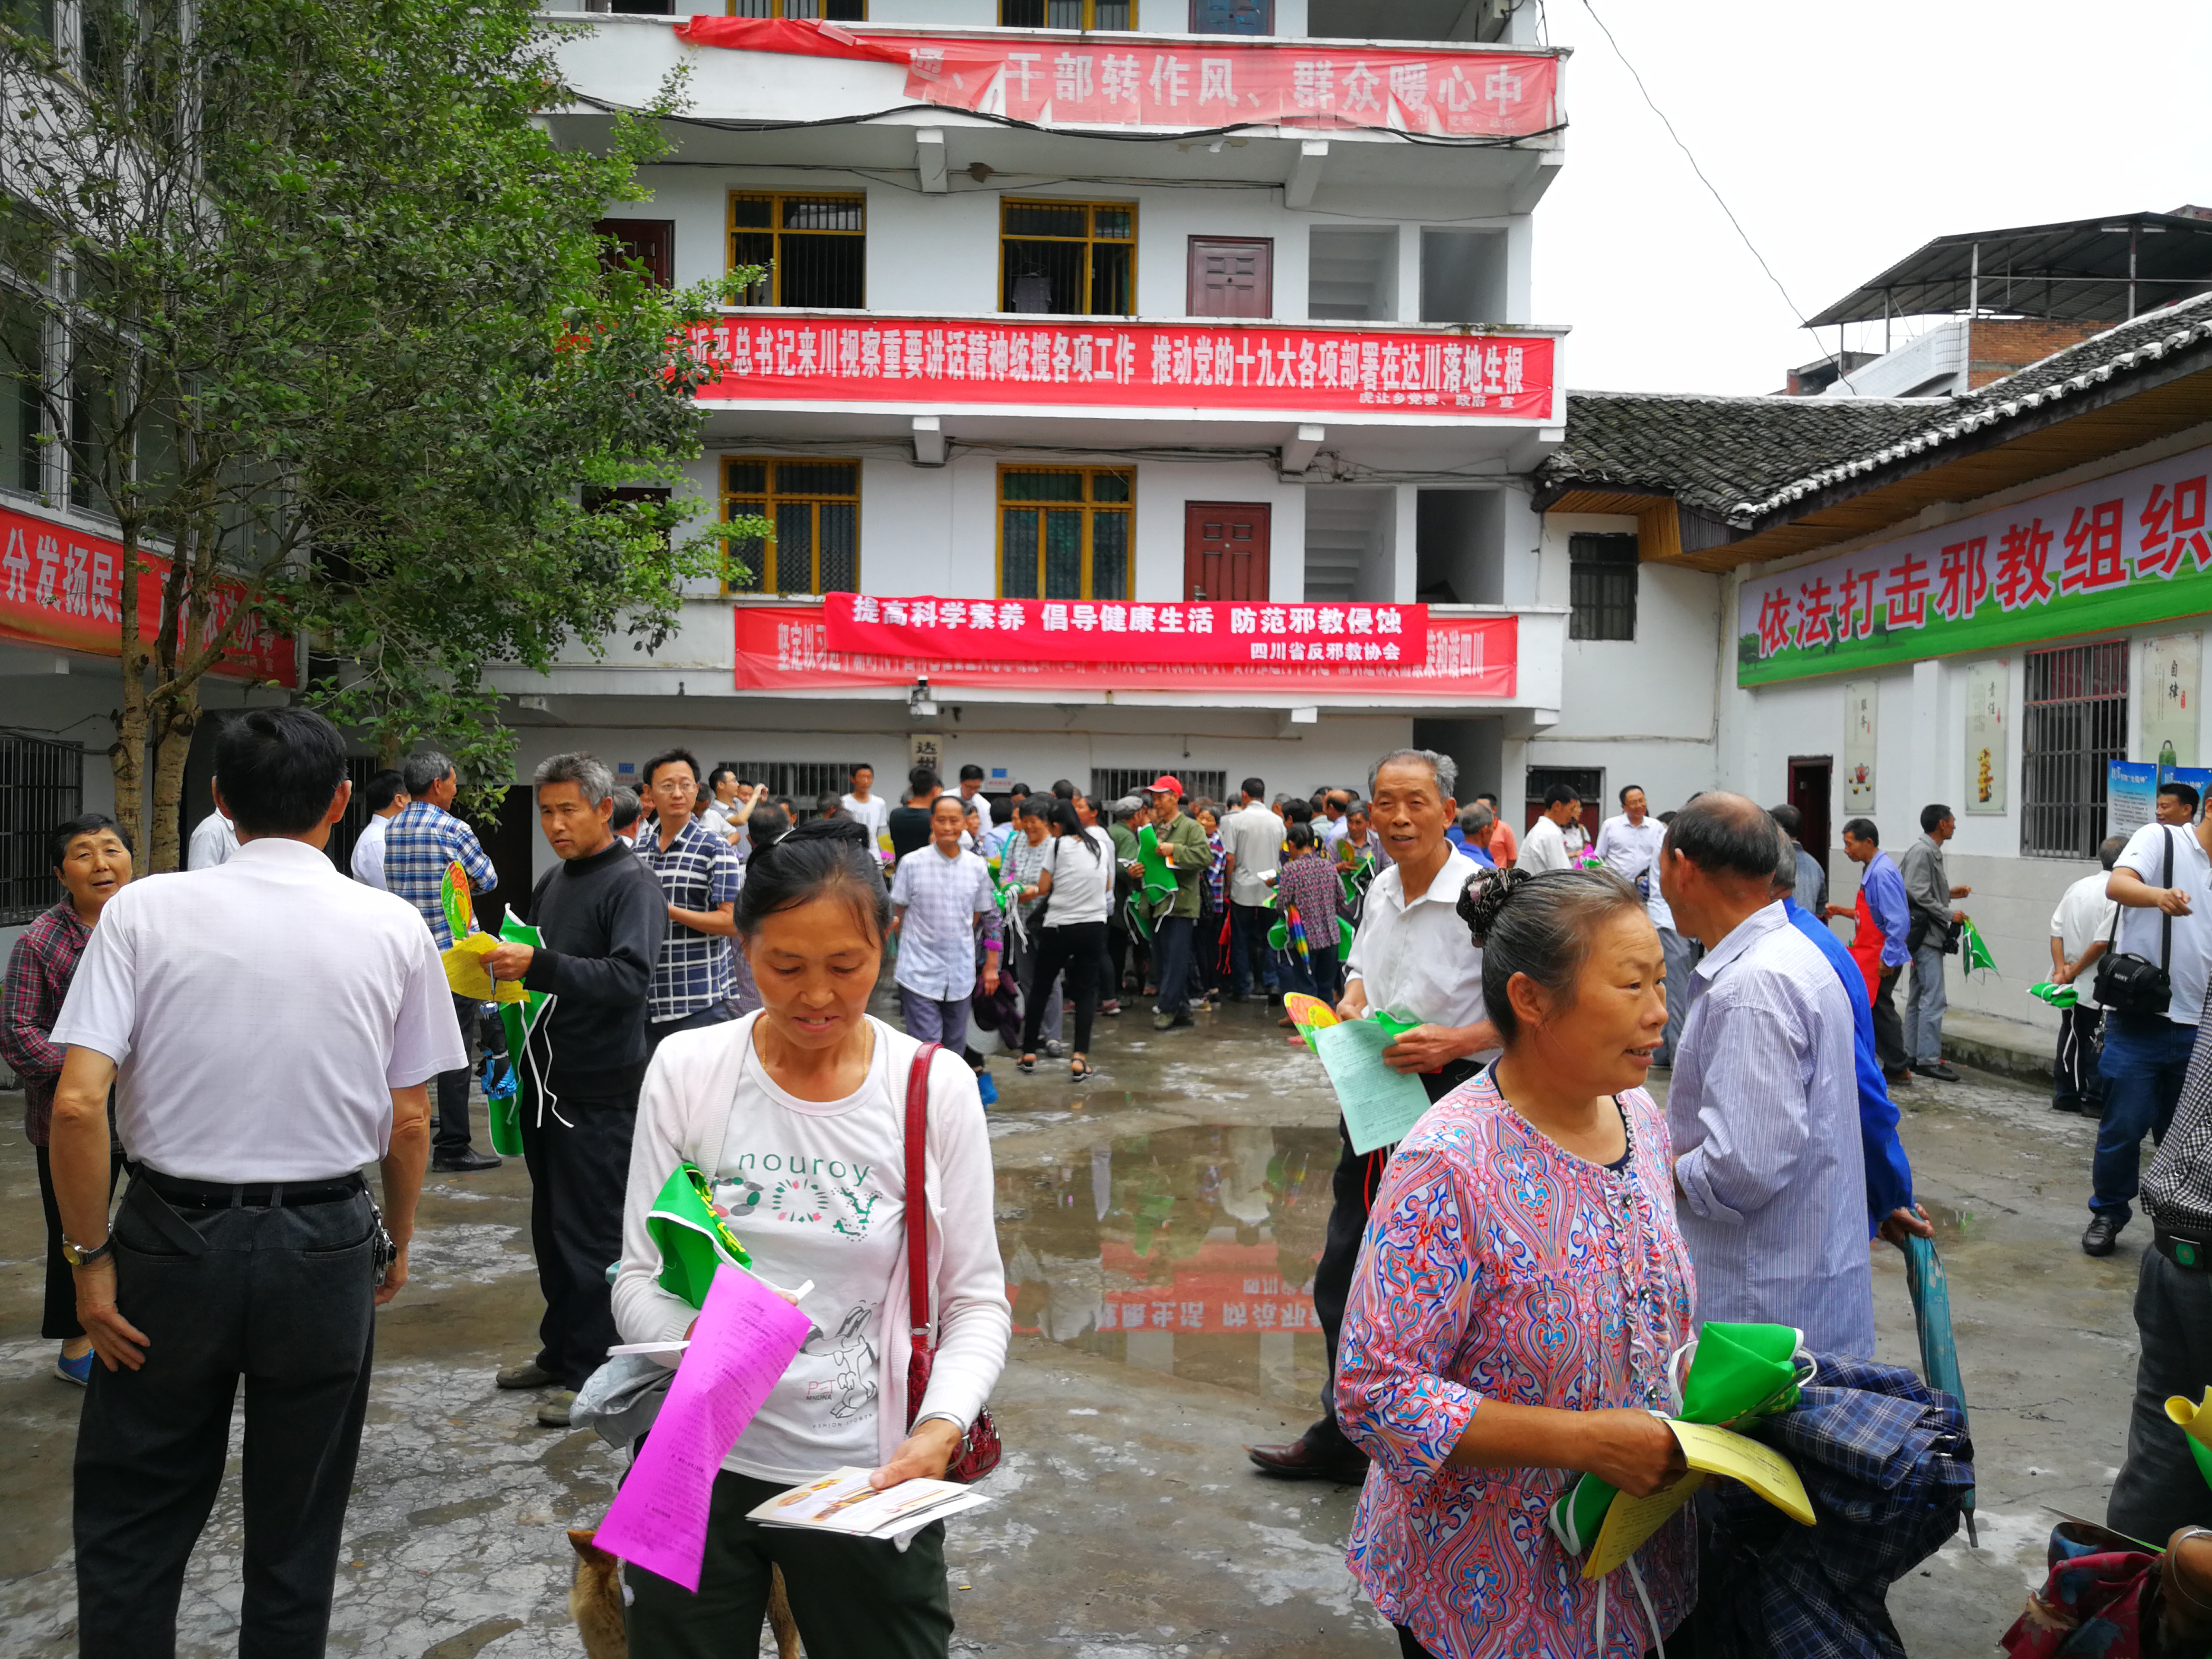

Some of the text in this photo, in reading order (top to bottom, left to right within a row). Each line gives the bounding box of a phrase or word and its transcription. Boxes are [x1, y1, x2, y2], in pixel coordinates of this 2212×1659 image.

[1151, 333, 1524, 394] 推动党的十九大各项部署在达川落地生根
[1500, 396, 1514, 408] 宣
[2, 527, 124, 623] 分发扬民
[1757, 475, 2212, 655] 依法打击邪教组织
[852, 596, 1403, 635] 提高科学素养 倡导健康生活 防范邪教侵蚀
[1250, 641, 1401, 662] 四川省反邪教协会
[739, 1154, 870, 1187] nouroy
[807, 1379, 836, 1395] PET
